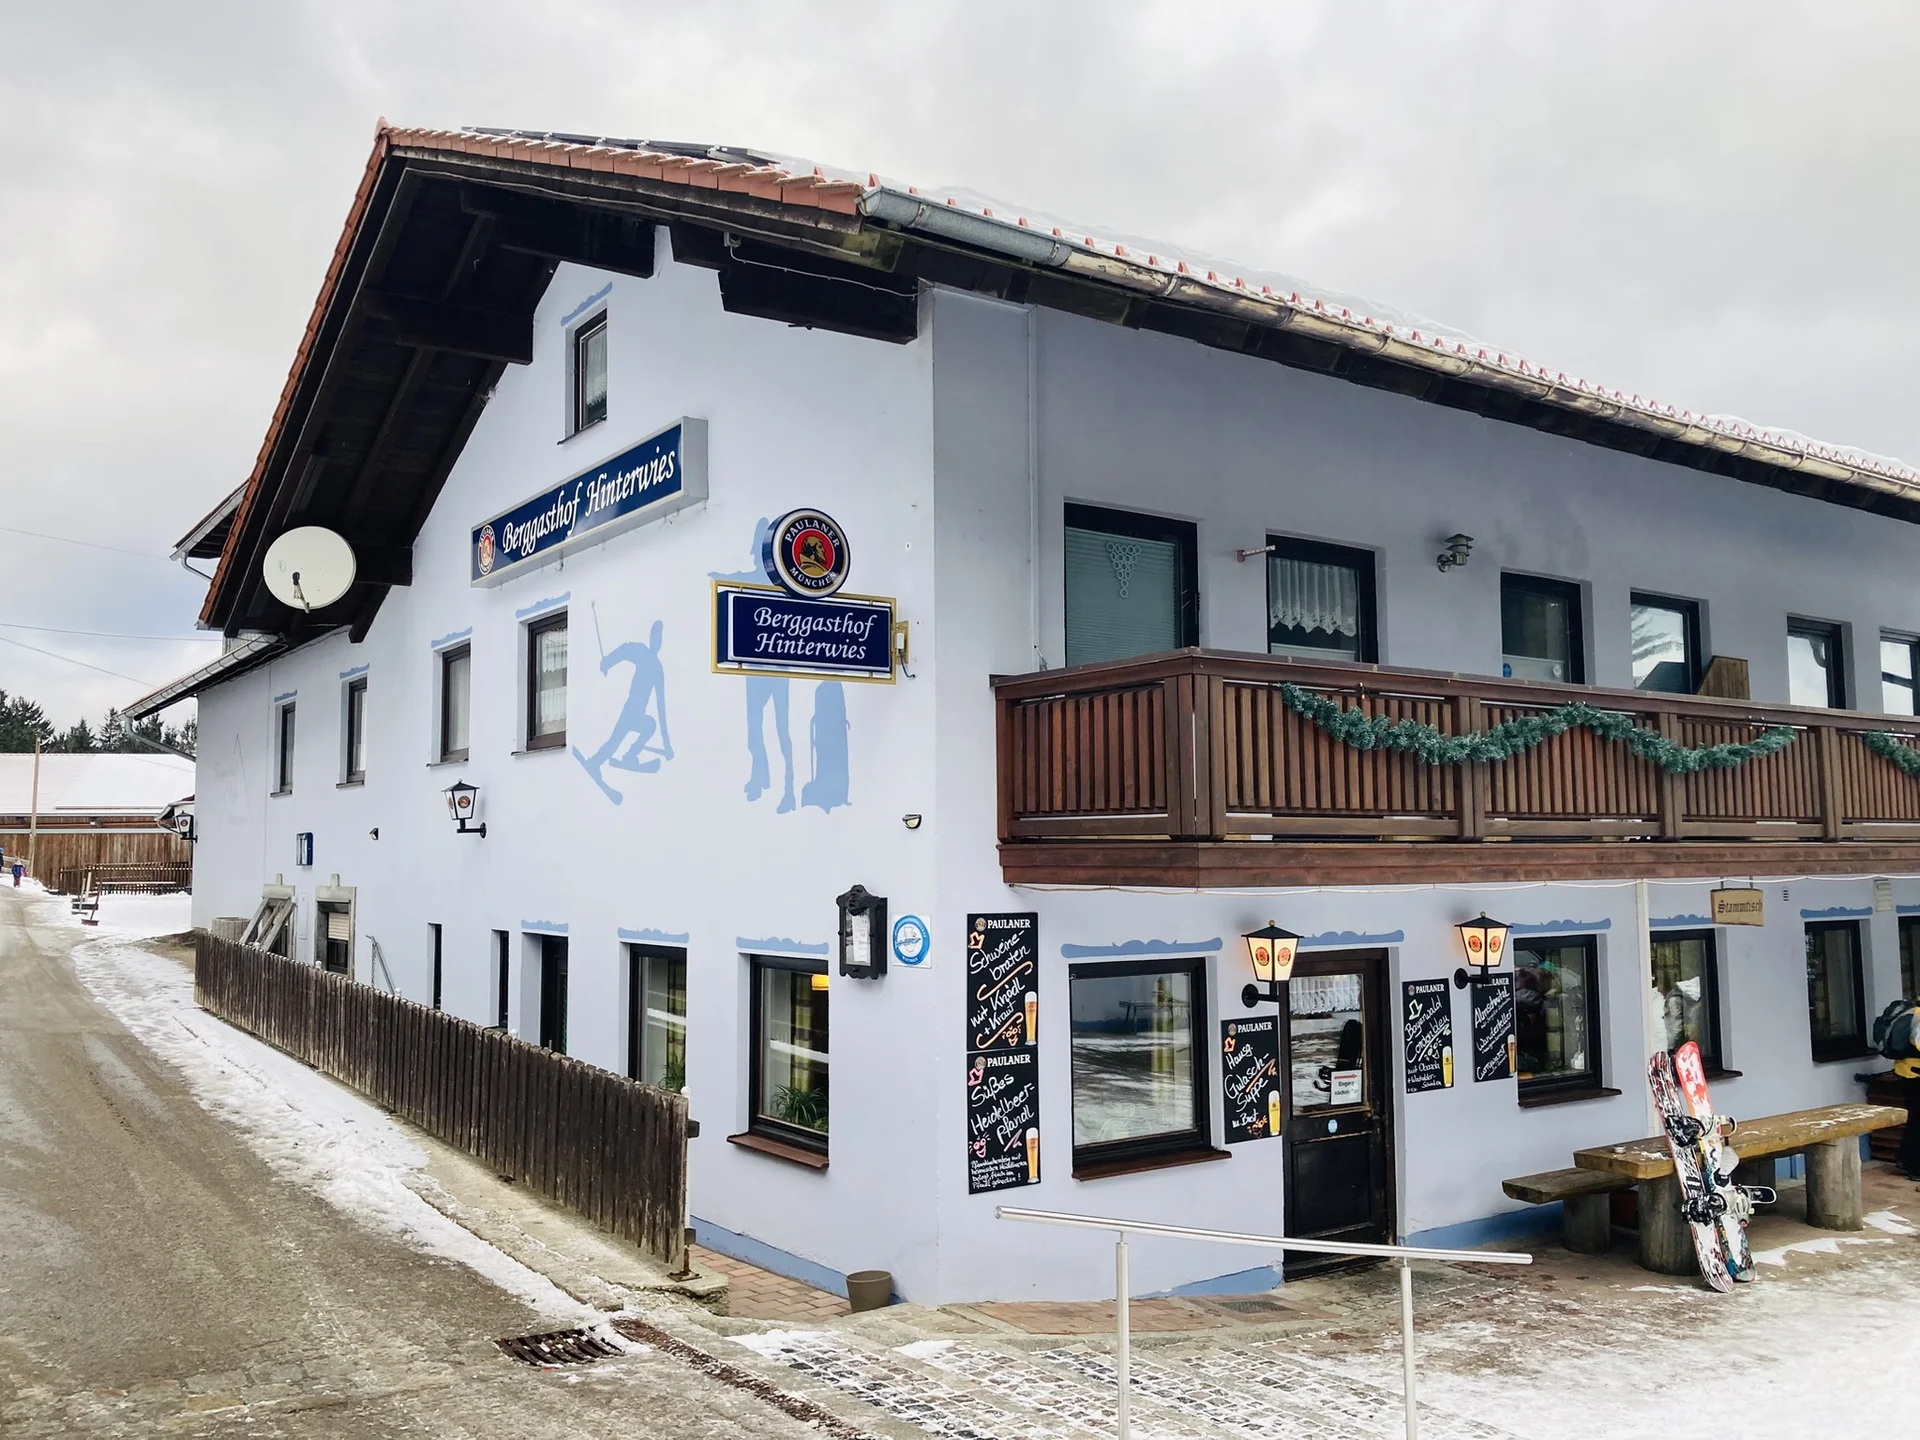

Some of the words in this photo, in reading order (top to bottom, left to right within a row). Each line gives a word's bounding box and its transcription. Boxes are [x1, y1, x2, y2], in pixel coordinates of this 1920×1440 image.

[502, 481, 583, 557] Berggasthof
[585, 446, 675, 517] Hinterwies
[785, 519, 840, 547] PAULANER
[790, 566, 838, 588] MÜNCHEN
[753, 606, 878, 642] Berggasthof
[754, 632, 867, 660] Hinterwies
[1718, 899, 1763, 914] Stammtisch
[987, 919, 1031, 929] PAULANER
[969, 930, 1025, 975] Schweine-
[989, 945, 1031, 981] braten
[970, 1004, 989, 1028] mit
[989, 977, 1026, 1012] Knödl
[1415, 983, 1445, 994] PAULANER
[1237, 1021, 1273, 1034] PAULANER
[987, 1054, 1031, 1068] PAULANER
[1224, 1053, 1269, 1099] Gulasch-
[970, 1073, 1015, 1107] Süßes
[1236, 1077, 1269, 1113] Suppe
